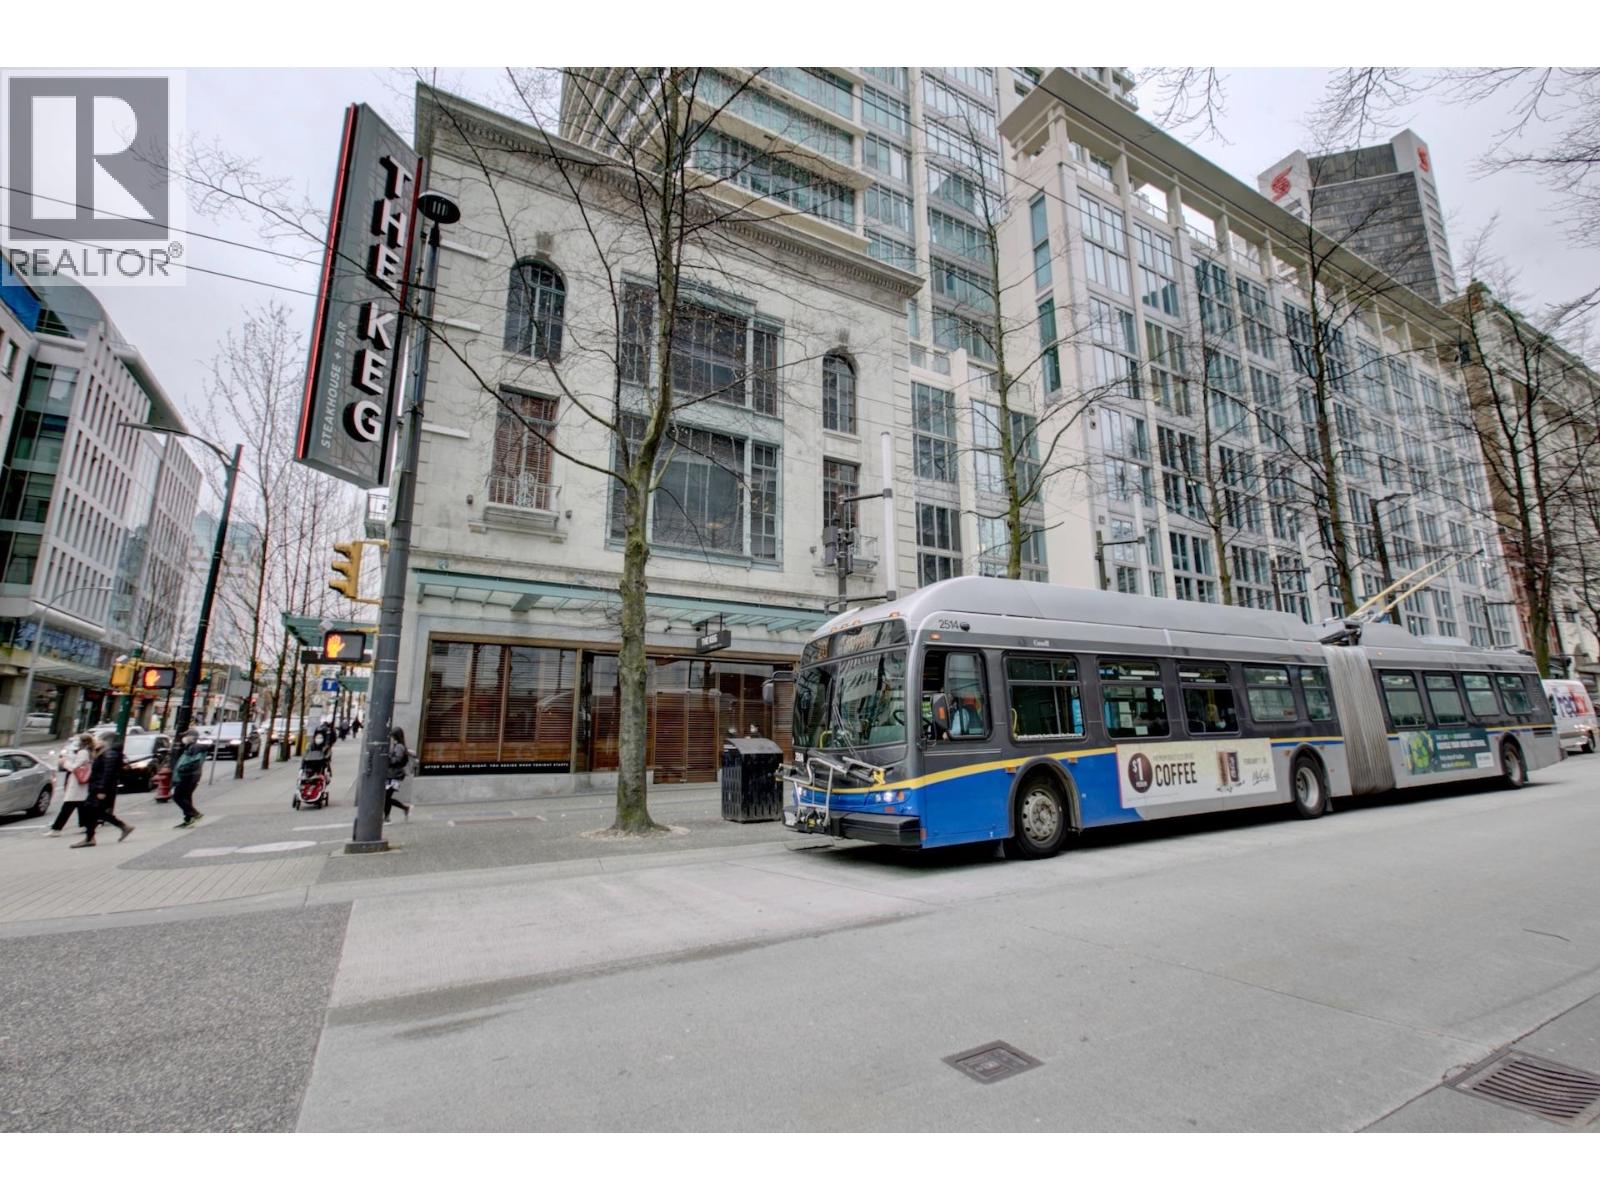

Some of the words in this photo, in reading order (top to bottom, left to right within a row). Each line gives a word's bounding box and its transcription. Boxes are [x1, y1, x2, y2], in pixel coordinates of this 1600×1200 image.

[371, 154, 413, 290] THE
[321, 363, 341, 449] STEAKHOUSE
[335, 321, 348, 348] BAR
[343, 302, 396, 442] KEG
[939, 619, 959, 630] 2514
[1132, 757, 1145, 781] $1
[1154, 762, 1198, 787] COFFEE
